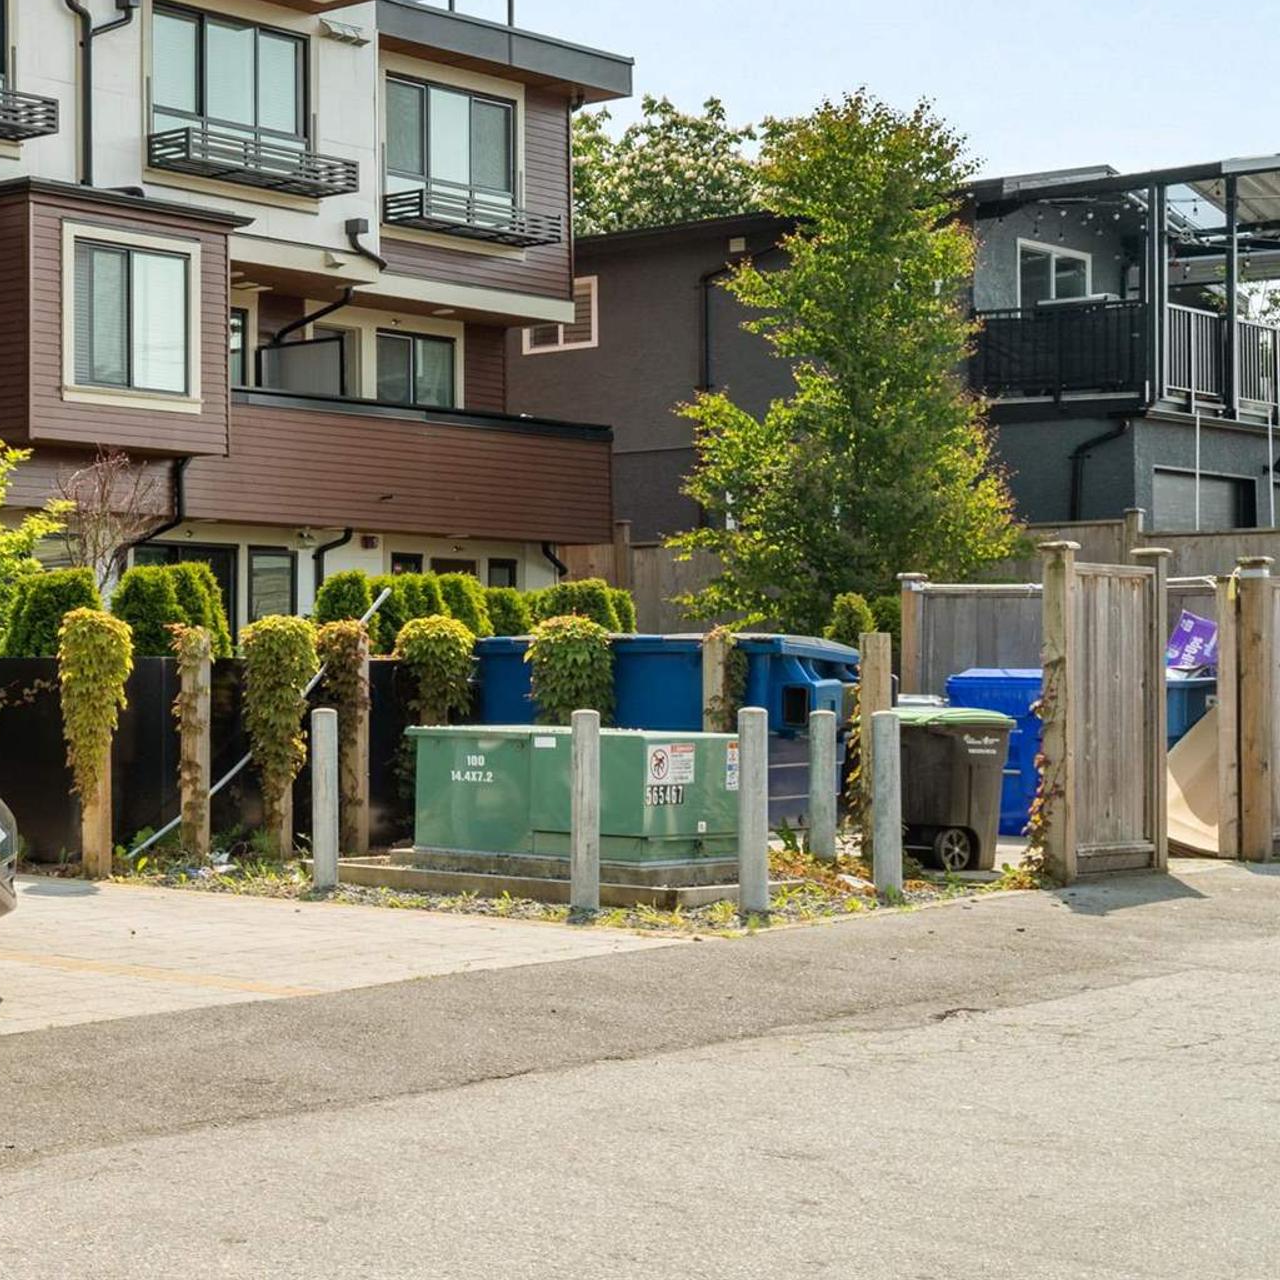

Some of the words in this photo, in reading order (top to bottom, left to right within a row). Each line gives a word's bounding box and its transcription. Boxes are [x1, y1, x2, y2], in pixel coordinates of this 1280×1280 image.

[467, 754, 485, 767] 100
[451, 770, 493, 783] 14.4X7.2
[645, 784, 684, 806] 565467
